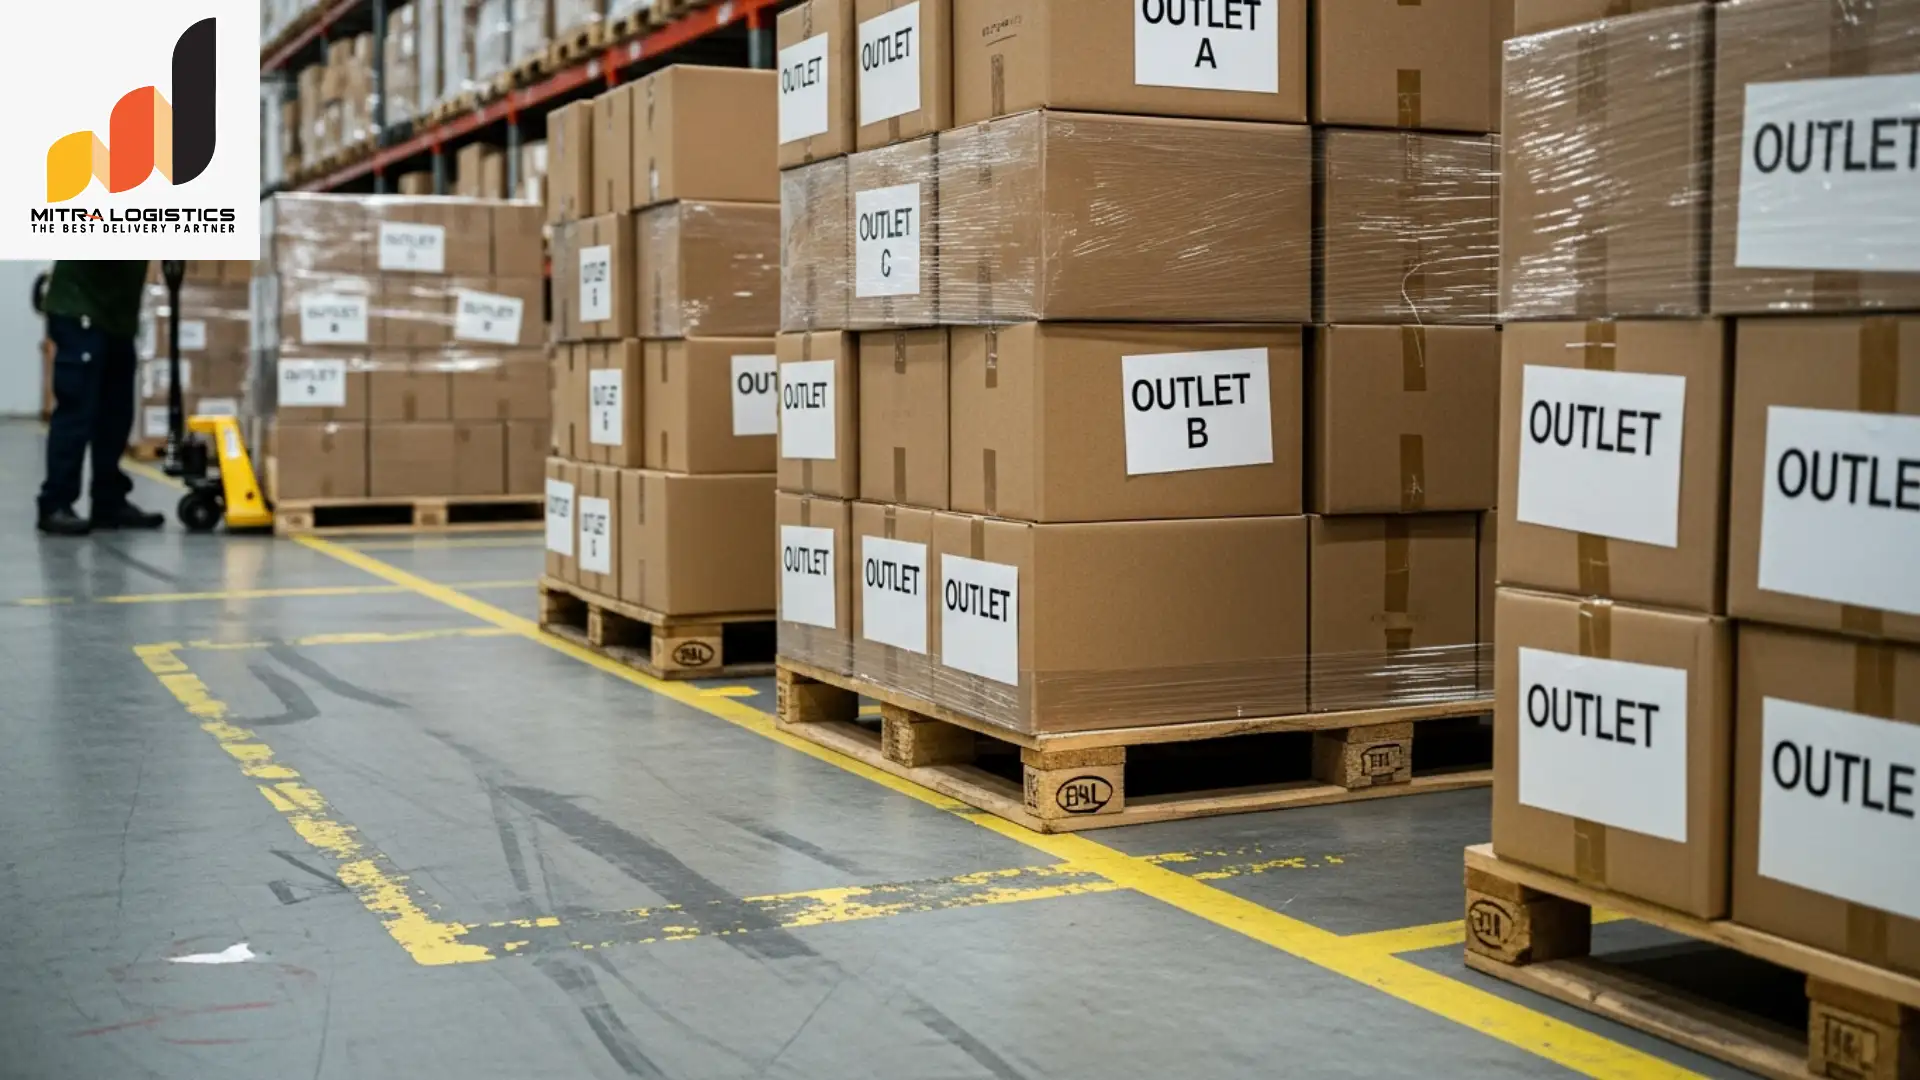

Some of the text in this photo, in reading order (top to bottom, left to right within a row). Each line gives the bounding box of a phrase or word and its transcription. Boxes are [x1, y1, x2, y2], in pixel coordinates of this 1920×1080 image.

[1142, 0, 1262, 31] OUTLET
[862, 26, 913, 72] OUTLET
[1194, 37, 1217, 70] A
[782, 56, 822, 94] OUTLET
[1753, 116, 1920, 174] OUTLET
[859, 207, 913, 242] OUTLET
[880, 248, 892, 278] C
[783, 381, 828, 410] OUTLET
[1131, 372, 1251, 412] OUTLET
[1187, 416, 1209, 449] B
[1529, 400, 1661, 456] OUTLET
[1777, 447, 1920, 512] OUTLE
[784, 545, 829, 576] OUTLET
[865, 557, 920, 596] OUTLET
[945, 578, 1011, 623] OUTLET
[1527, 683, 1660, 748] OUTLET
[1772, 740, 1916, 819] OUTLE
